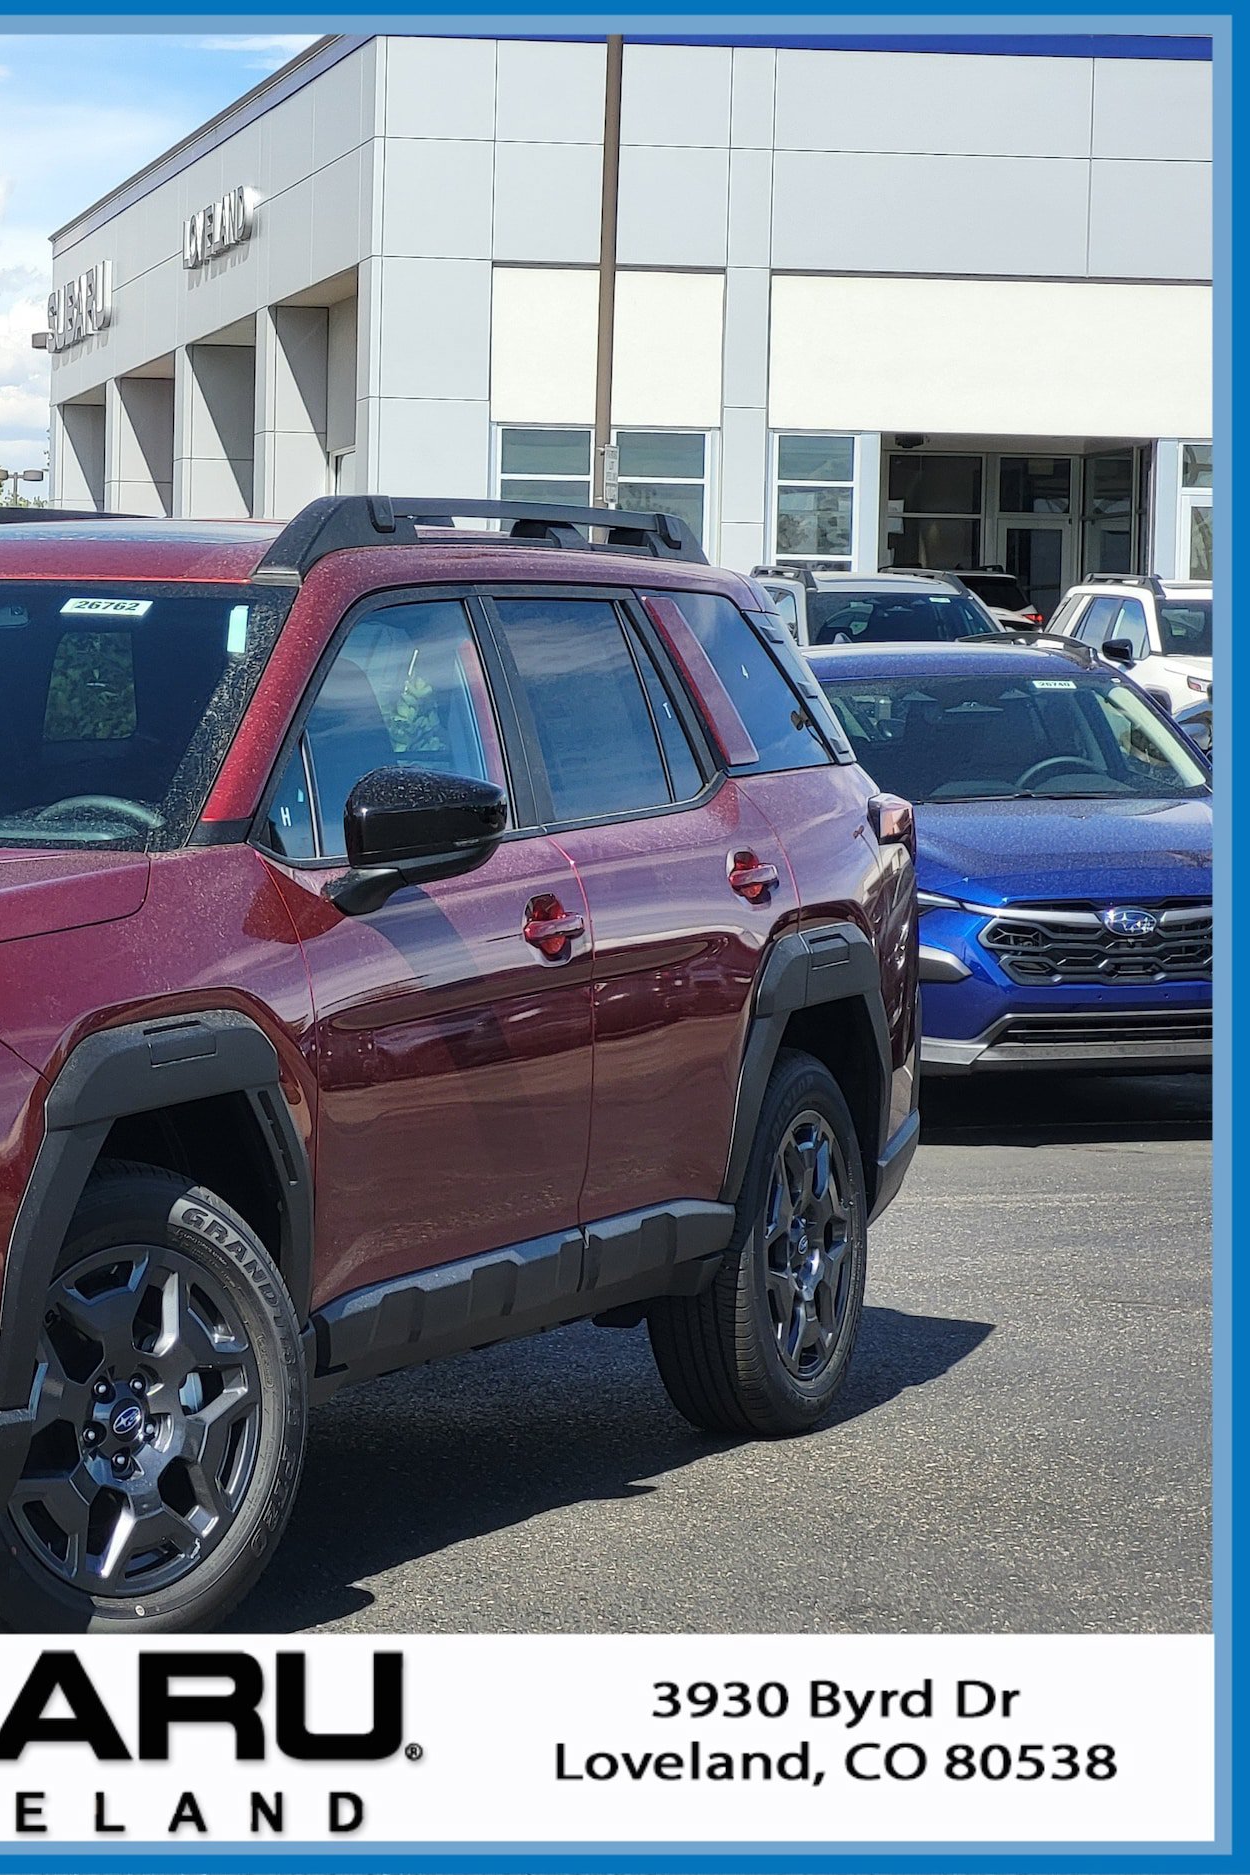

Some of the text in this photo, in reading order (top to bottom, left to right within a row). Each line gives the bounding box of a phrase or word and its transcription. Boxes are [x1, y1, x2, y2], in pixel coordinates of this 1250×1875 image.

[182, 185, 255, 270] LOVELAND
[47, 260, 113, 353] SUBARU
[74, 600, 140, 612] 26762
